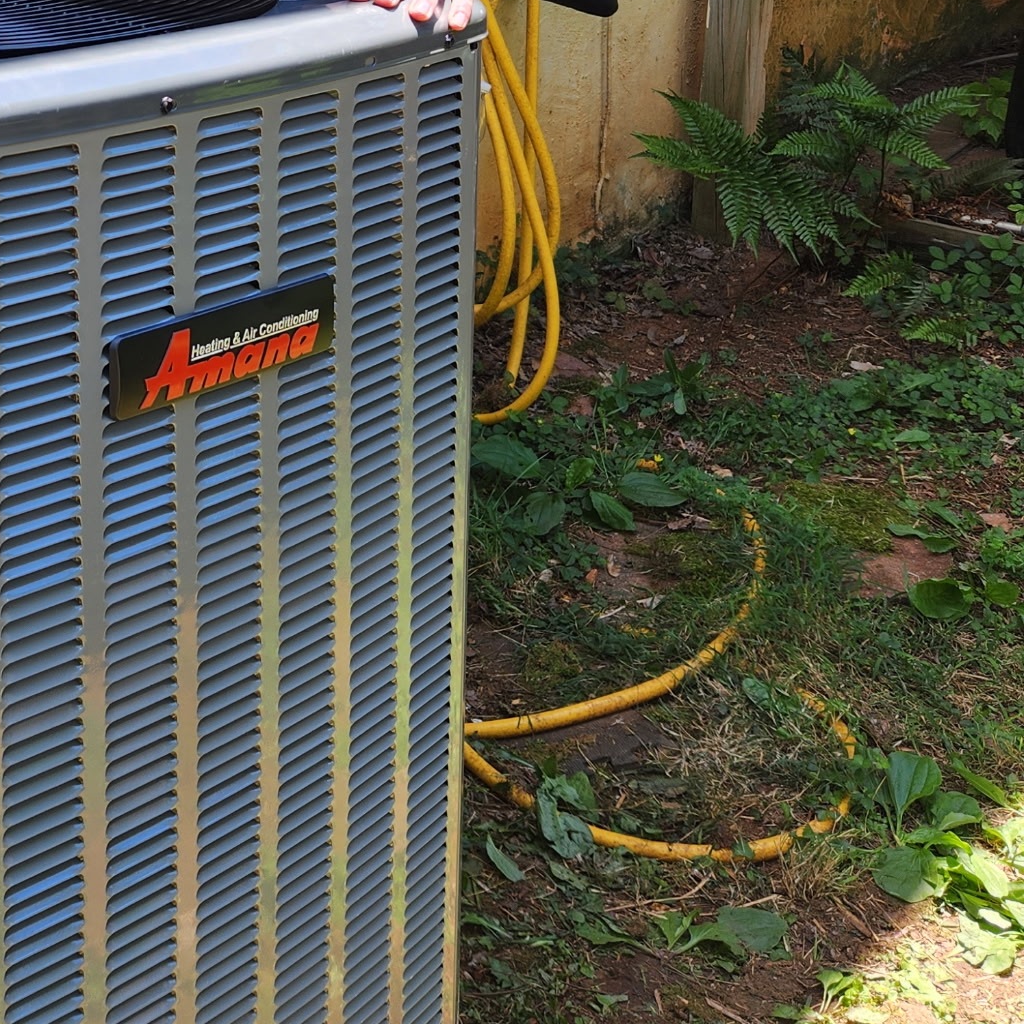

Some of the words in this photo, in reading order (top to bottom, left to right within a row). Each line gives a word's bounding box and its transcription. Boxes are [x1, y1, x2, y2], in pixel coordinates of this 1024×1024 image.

[139, 323, 320, 410] Amana
[191, 336, 231, 357] Heating
[232, 331, 242, 346] &
[241, 326, 258, 343] Air
[259, 308, 319, 336] Conditioning
